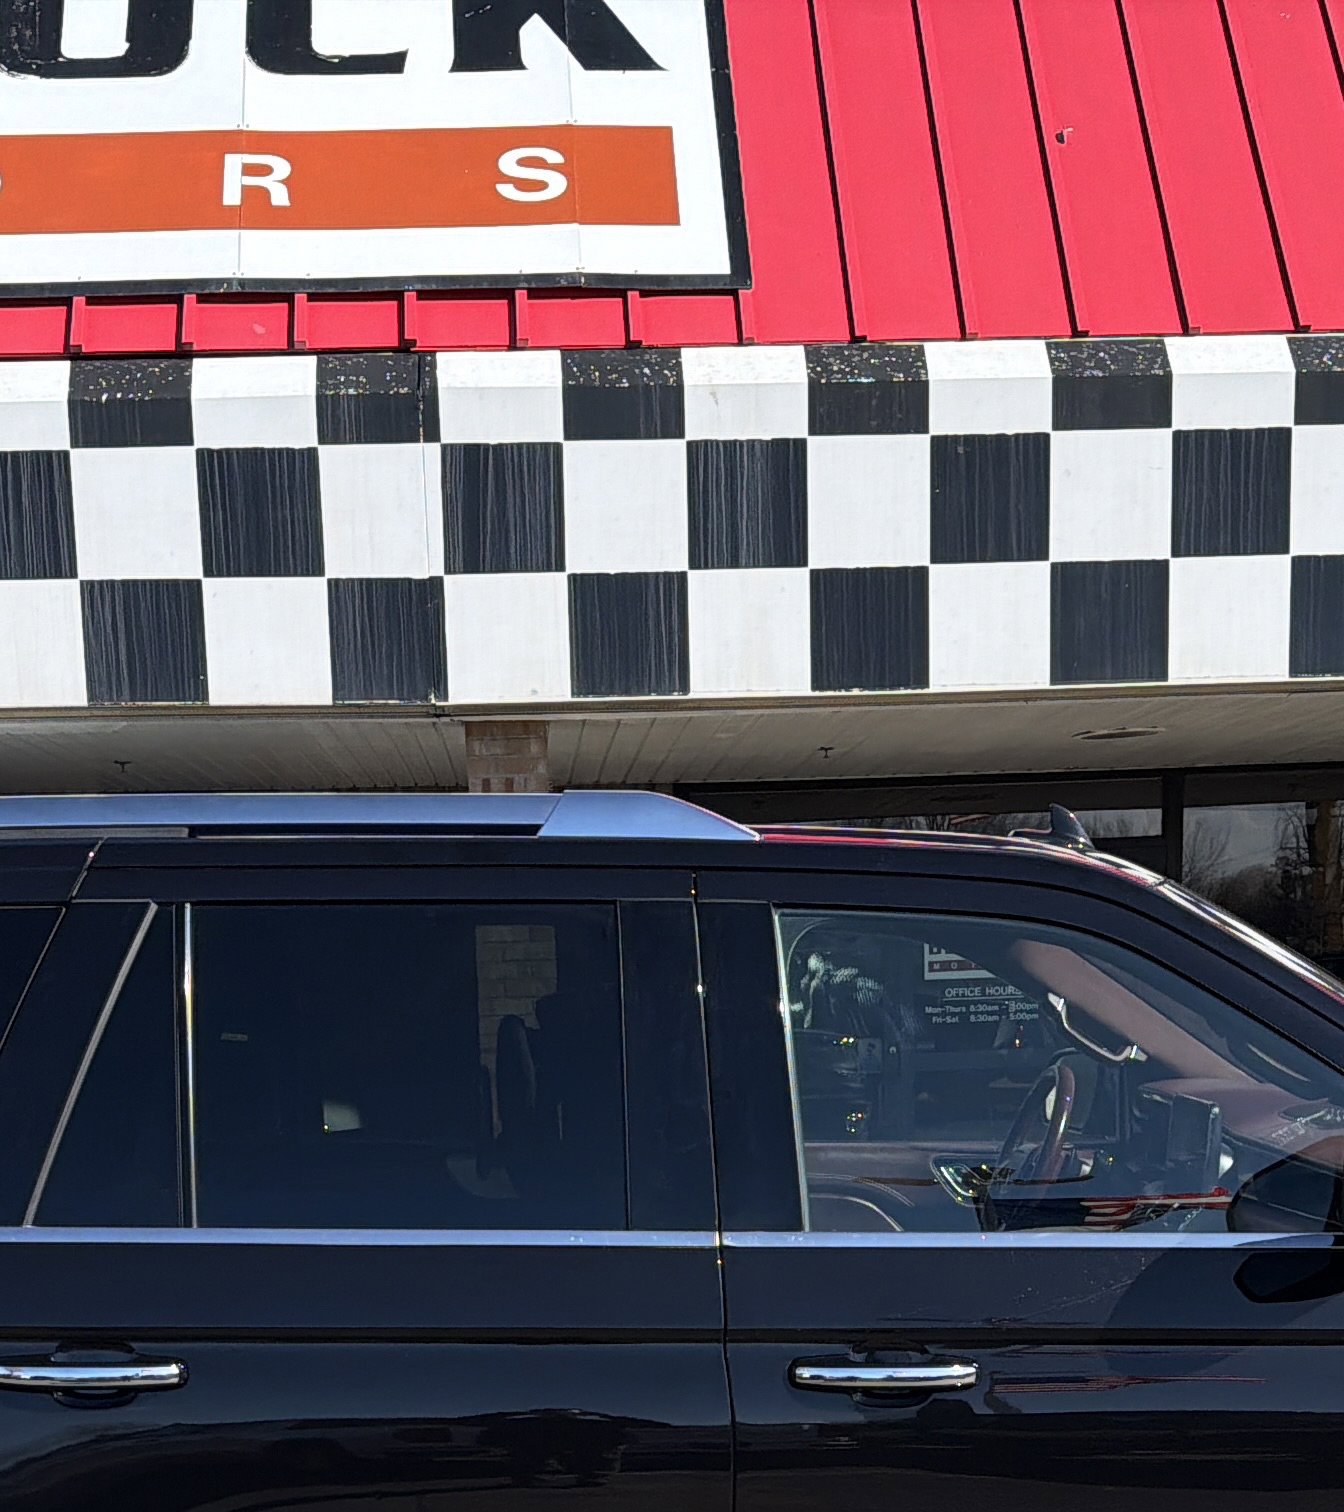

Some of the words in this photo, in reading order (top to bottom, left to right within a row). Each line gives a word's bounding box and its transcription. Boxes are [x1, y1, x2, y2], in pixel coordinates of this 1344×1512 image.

[944, 987, 982, 998] OFFICE
[969, 1003, 1000, 1013] 8:30am
[932, 1015, 959, 1024] Fri-Sat
[969, 1013, 1000, 1023] 8:30am
